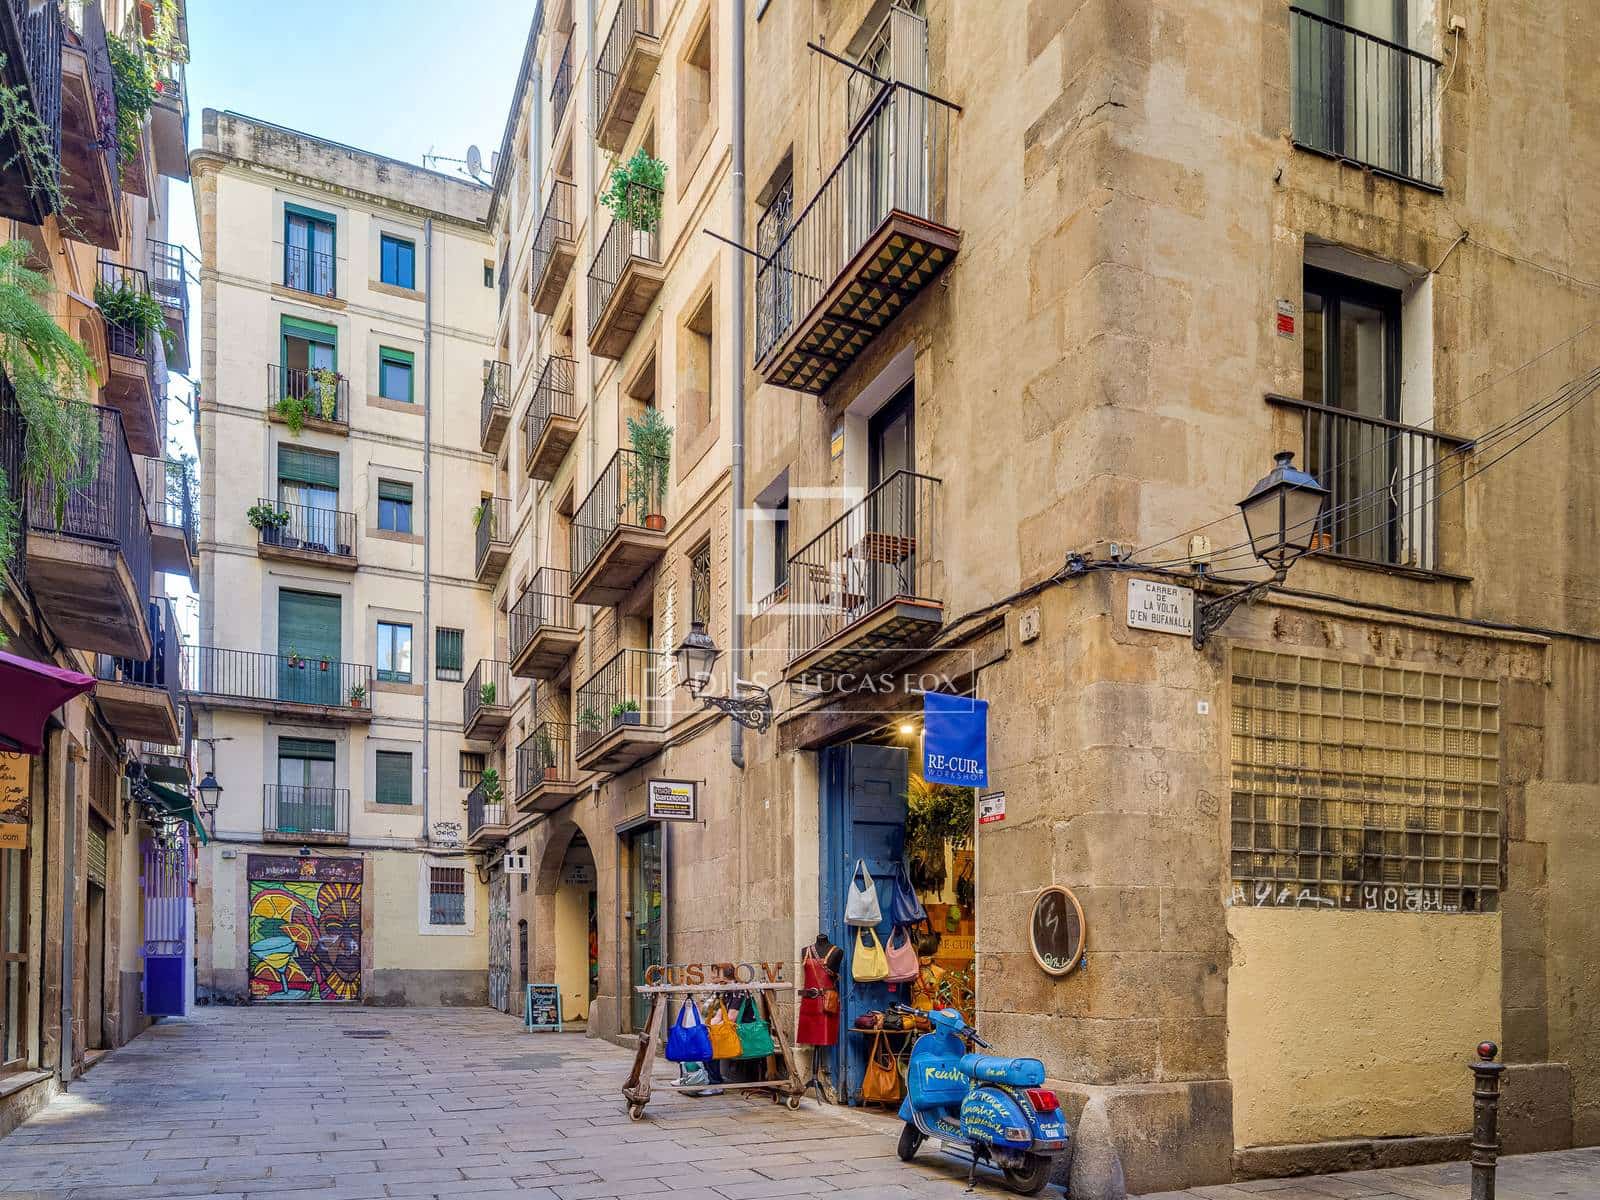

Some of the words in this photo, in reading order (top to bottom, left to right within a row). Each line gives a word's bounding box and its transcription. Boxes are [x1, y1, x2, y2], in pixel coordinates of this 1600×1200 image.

[1146, 584, 1177, 596] CARRER
[1156, 594, 1167, 602] DE
[1143, 600, 1154, 610] LA
[1157, 602, 1179, 614] VOLTA
[1130, 609, 1147, 622] D'EN
[1151, 613, 1192, 629] BUFANALLA
[927, 754, 979, 774] RE-CUIR
[927, 768, 984, 781] WORKSHOP
